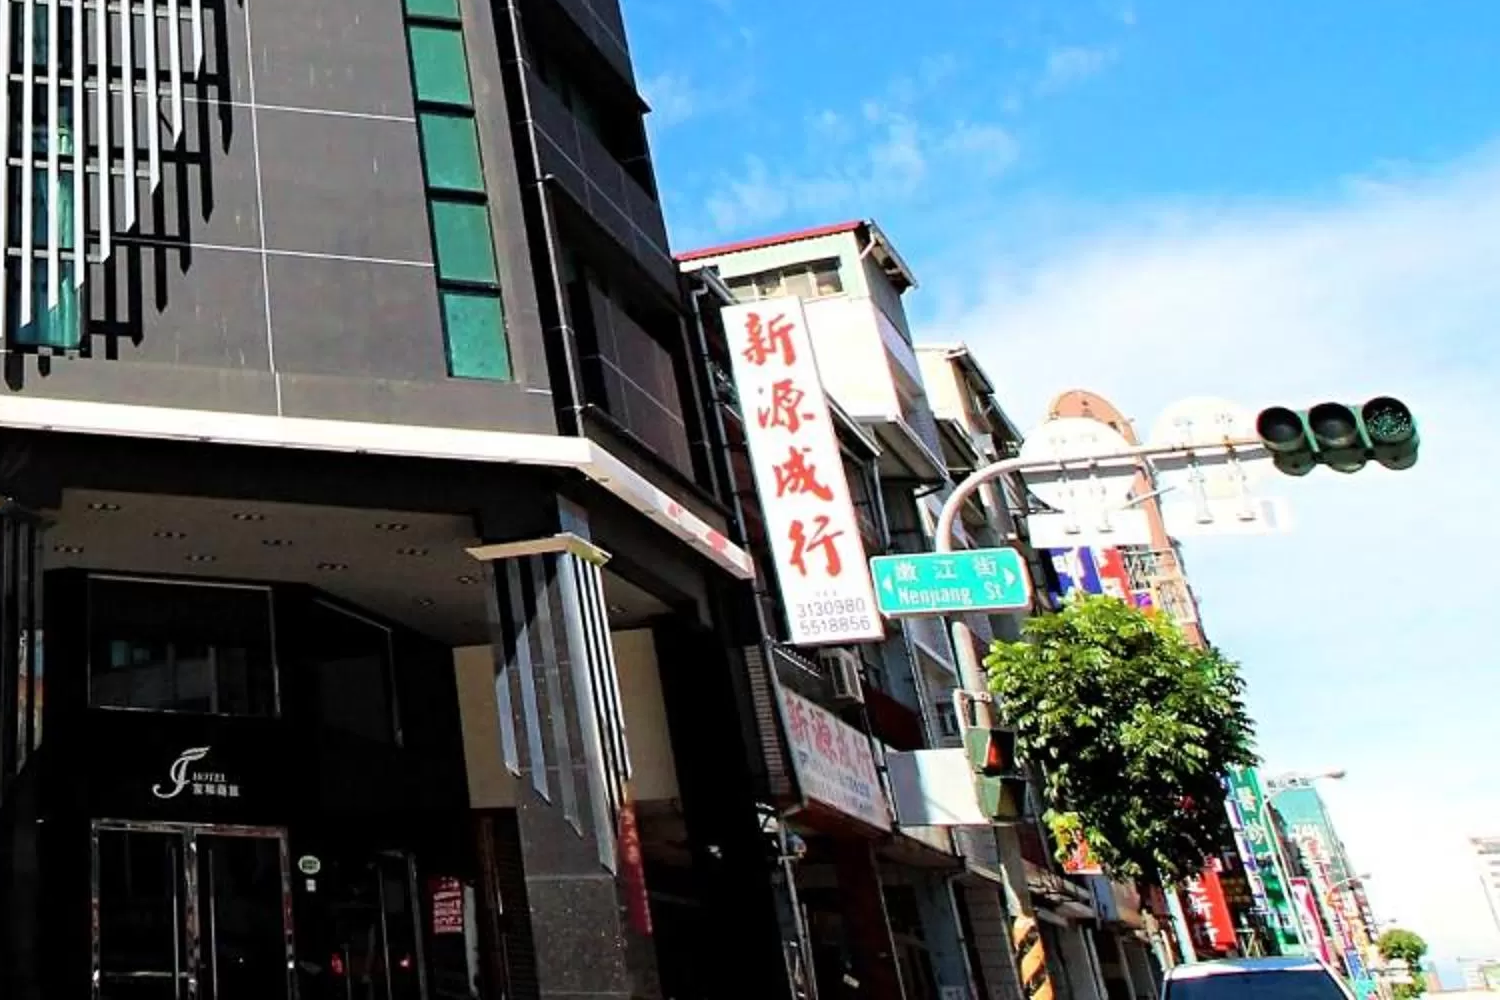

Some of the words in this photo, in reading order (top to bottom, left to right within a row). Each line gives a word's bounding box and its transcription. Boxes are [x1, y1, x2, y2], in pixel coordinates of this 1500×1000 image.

[741, 310, 845, 578] 新源成行
[894, 555, 997, 583] 嫩江街
[897, 586, 973, 607] Nenjiang
[796, 597, 866, 618] 3130980
[799, 615, 871, 636] 5518856
[192, 771, 227, 783] HOTEL
